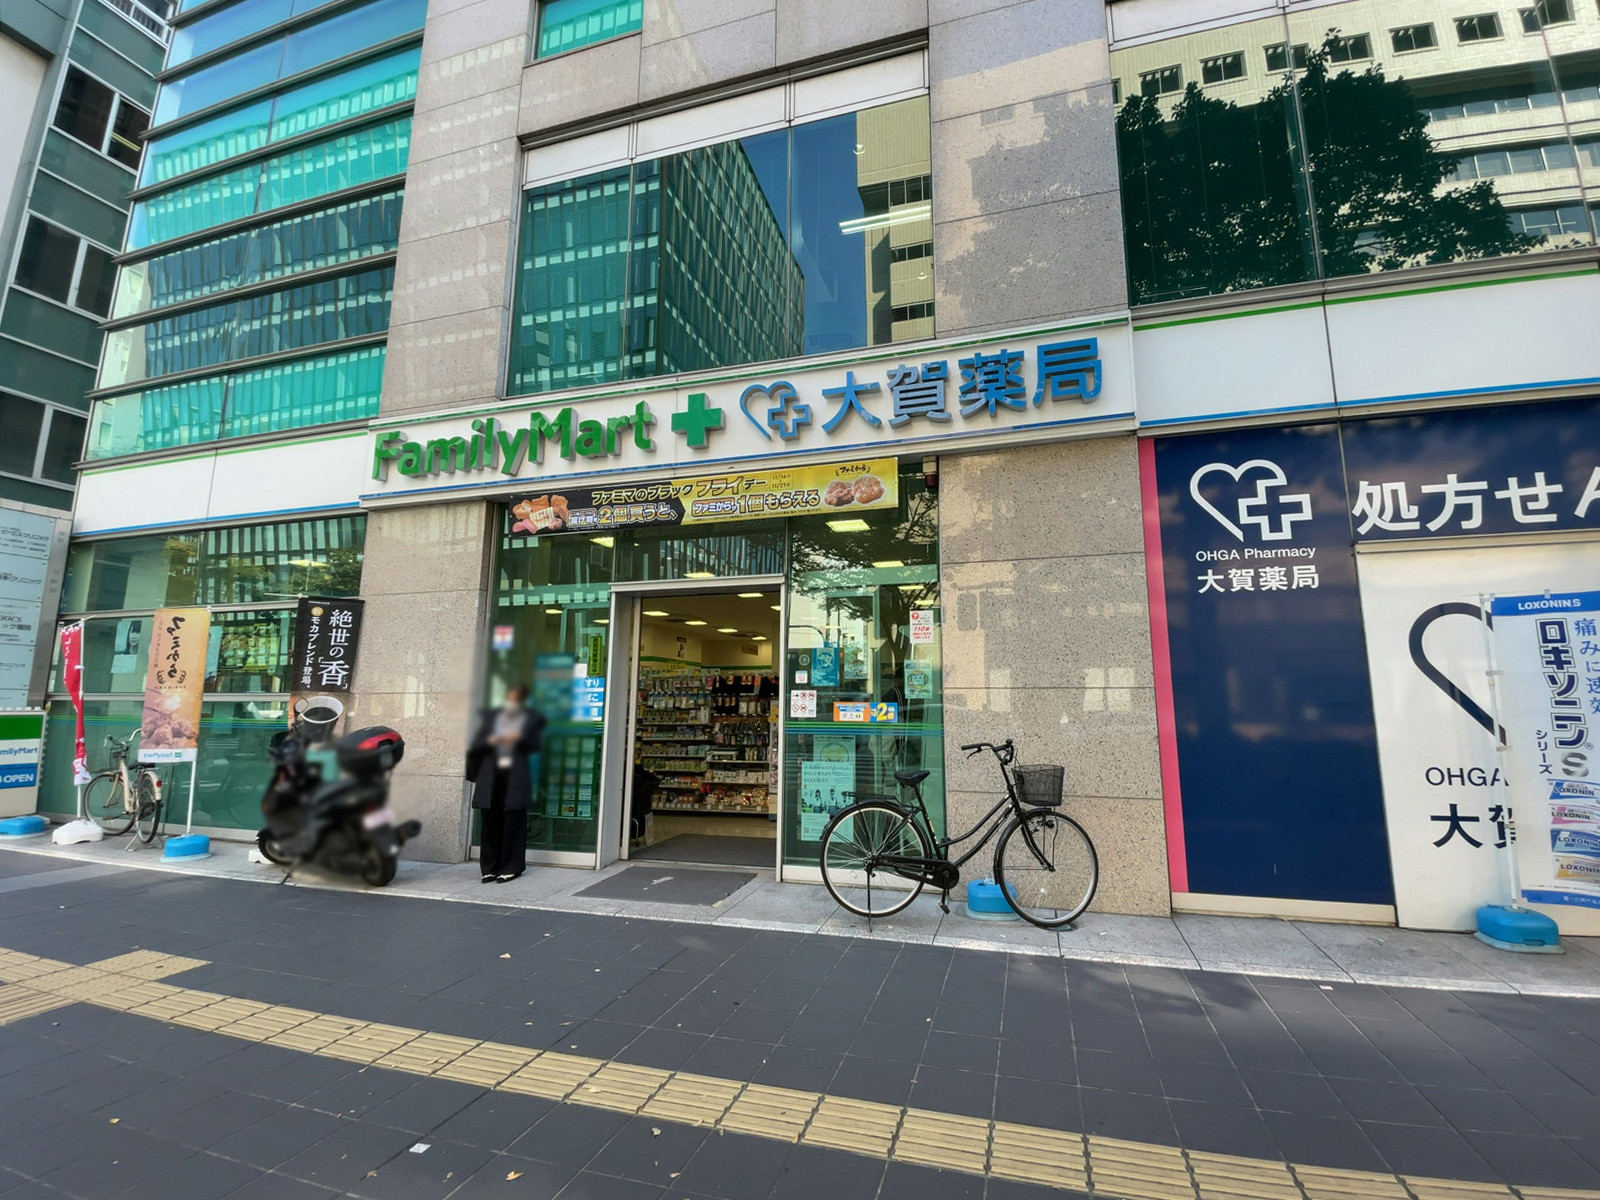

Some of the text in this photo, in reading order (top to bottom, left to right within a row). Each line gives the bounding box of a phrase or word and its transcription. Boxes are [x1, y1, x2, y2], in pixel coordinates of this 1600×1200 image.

[821, 337, 1102, 434] 大賀薬局
[372, 400, 658, 482] FamilyMart
[1195, 547, 1316, 562] OHGA Pharmacy
[1197, 564, 1319, 594] 大賀薬局
[1535, 729, 1553, 775] シリーズ
[3, 774, 34, 783] OPEN
[1425, 767, 1509, 786] OHGA
[1551, 812, 1590, 820] LOXONIN
[1558, 836, 1599, 848] LOXONIN
